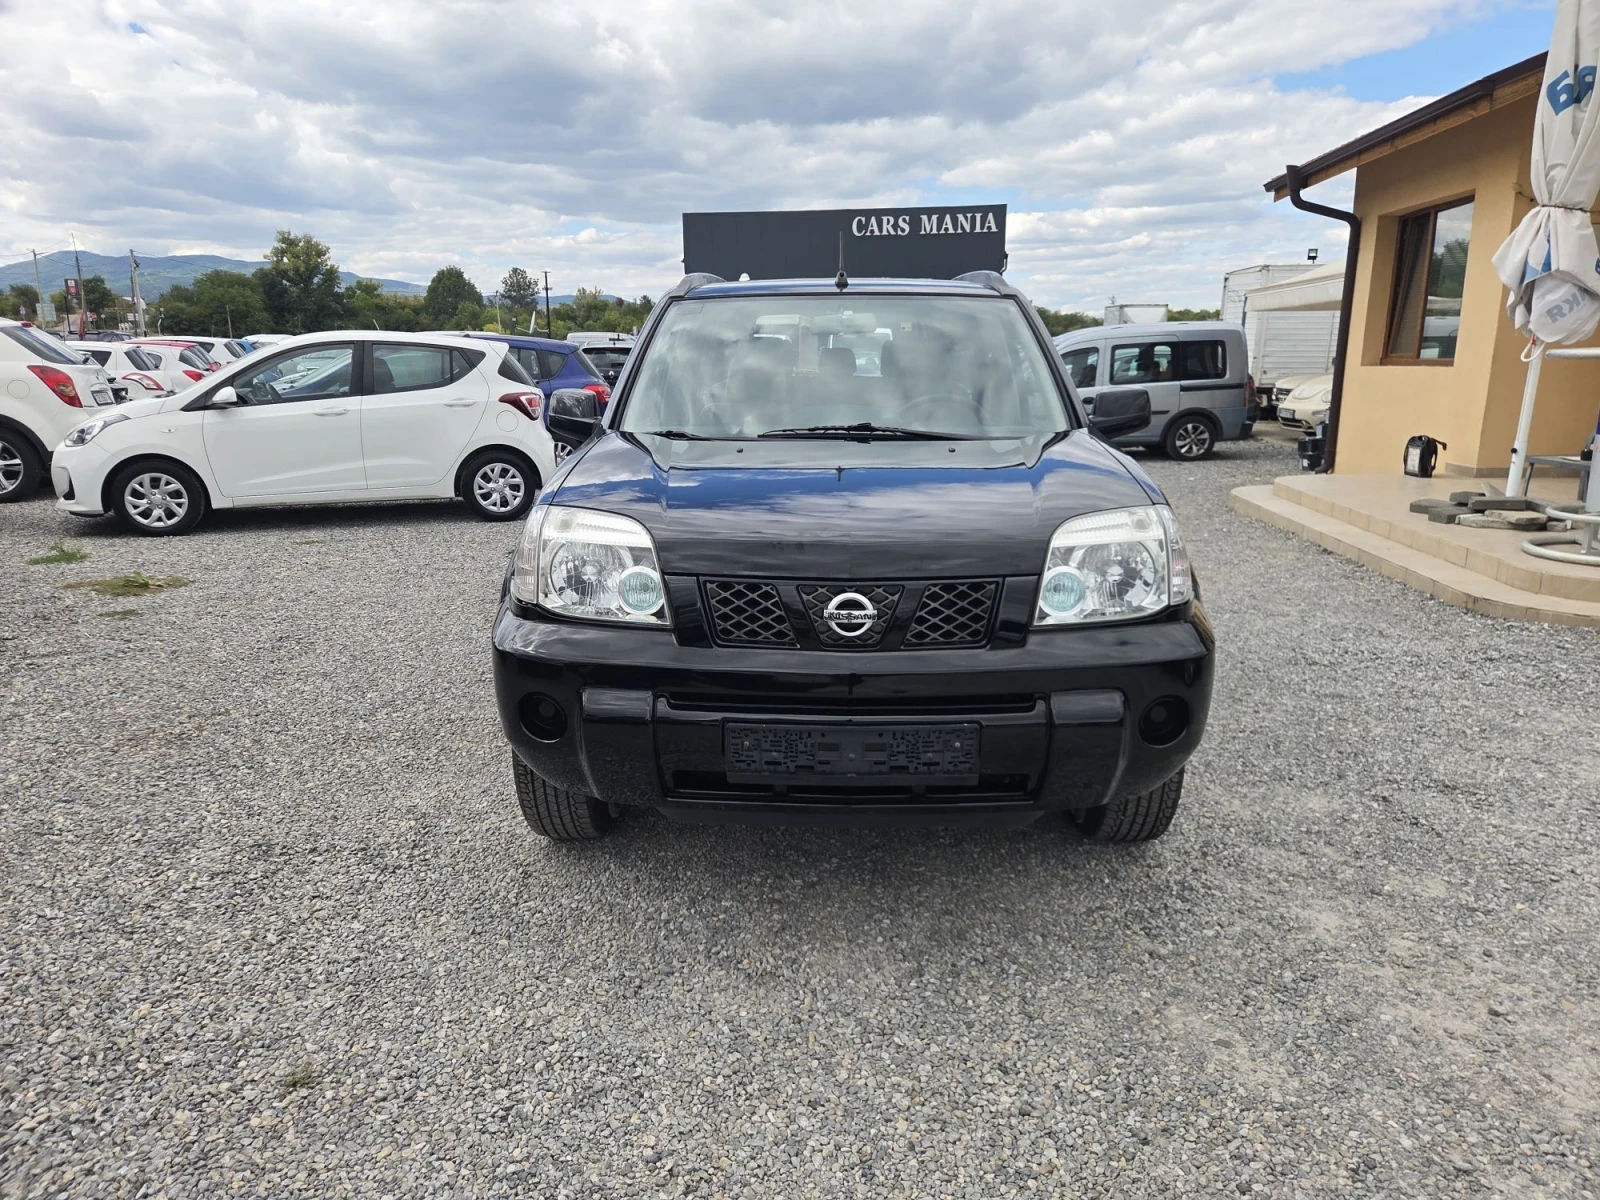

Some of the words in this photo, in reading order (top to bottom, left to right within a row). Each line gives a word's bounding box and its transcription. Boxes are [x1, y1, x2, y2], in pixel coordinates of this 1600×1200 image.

[851, 215, 910, 237] CARS
[919, 212, 998, 235] MANIA
[825, 610, 876, 621] NISSAN
